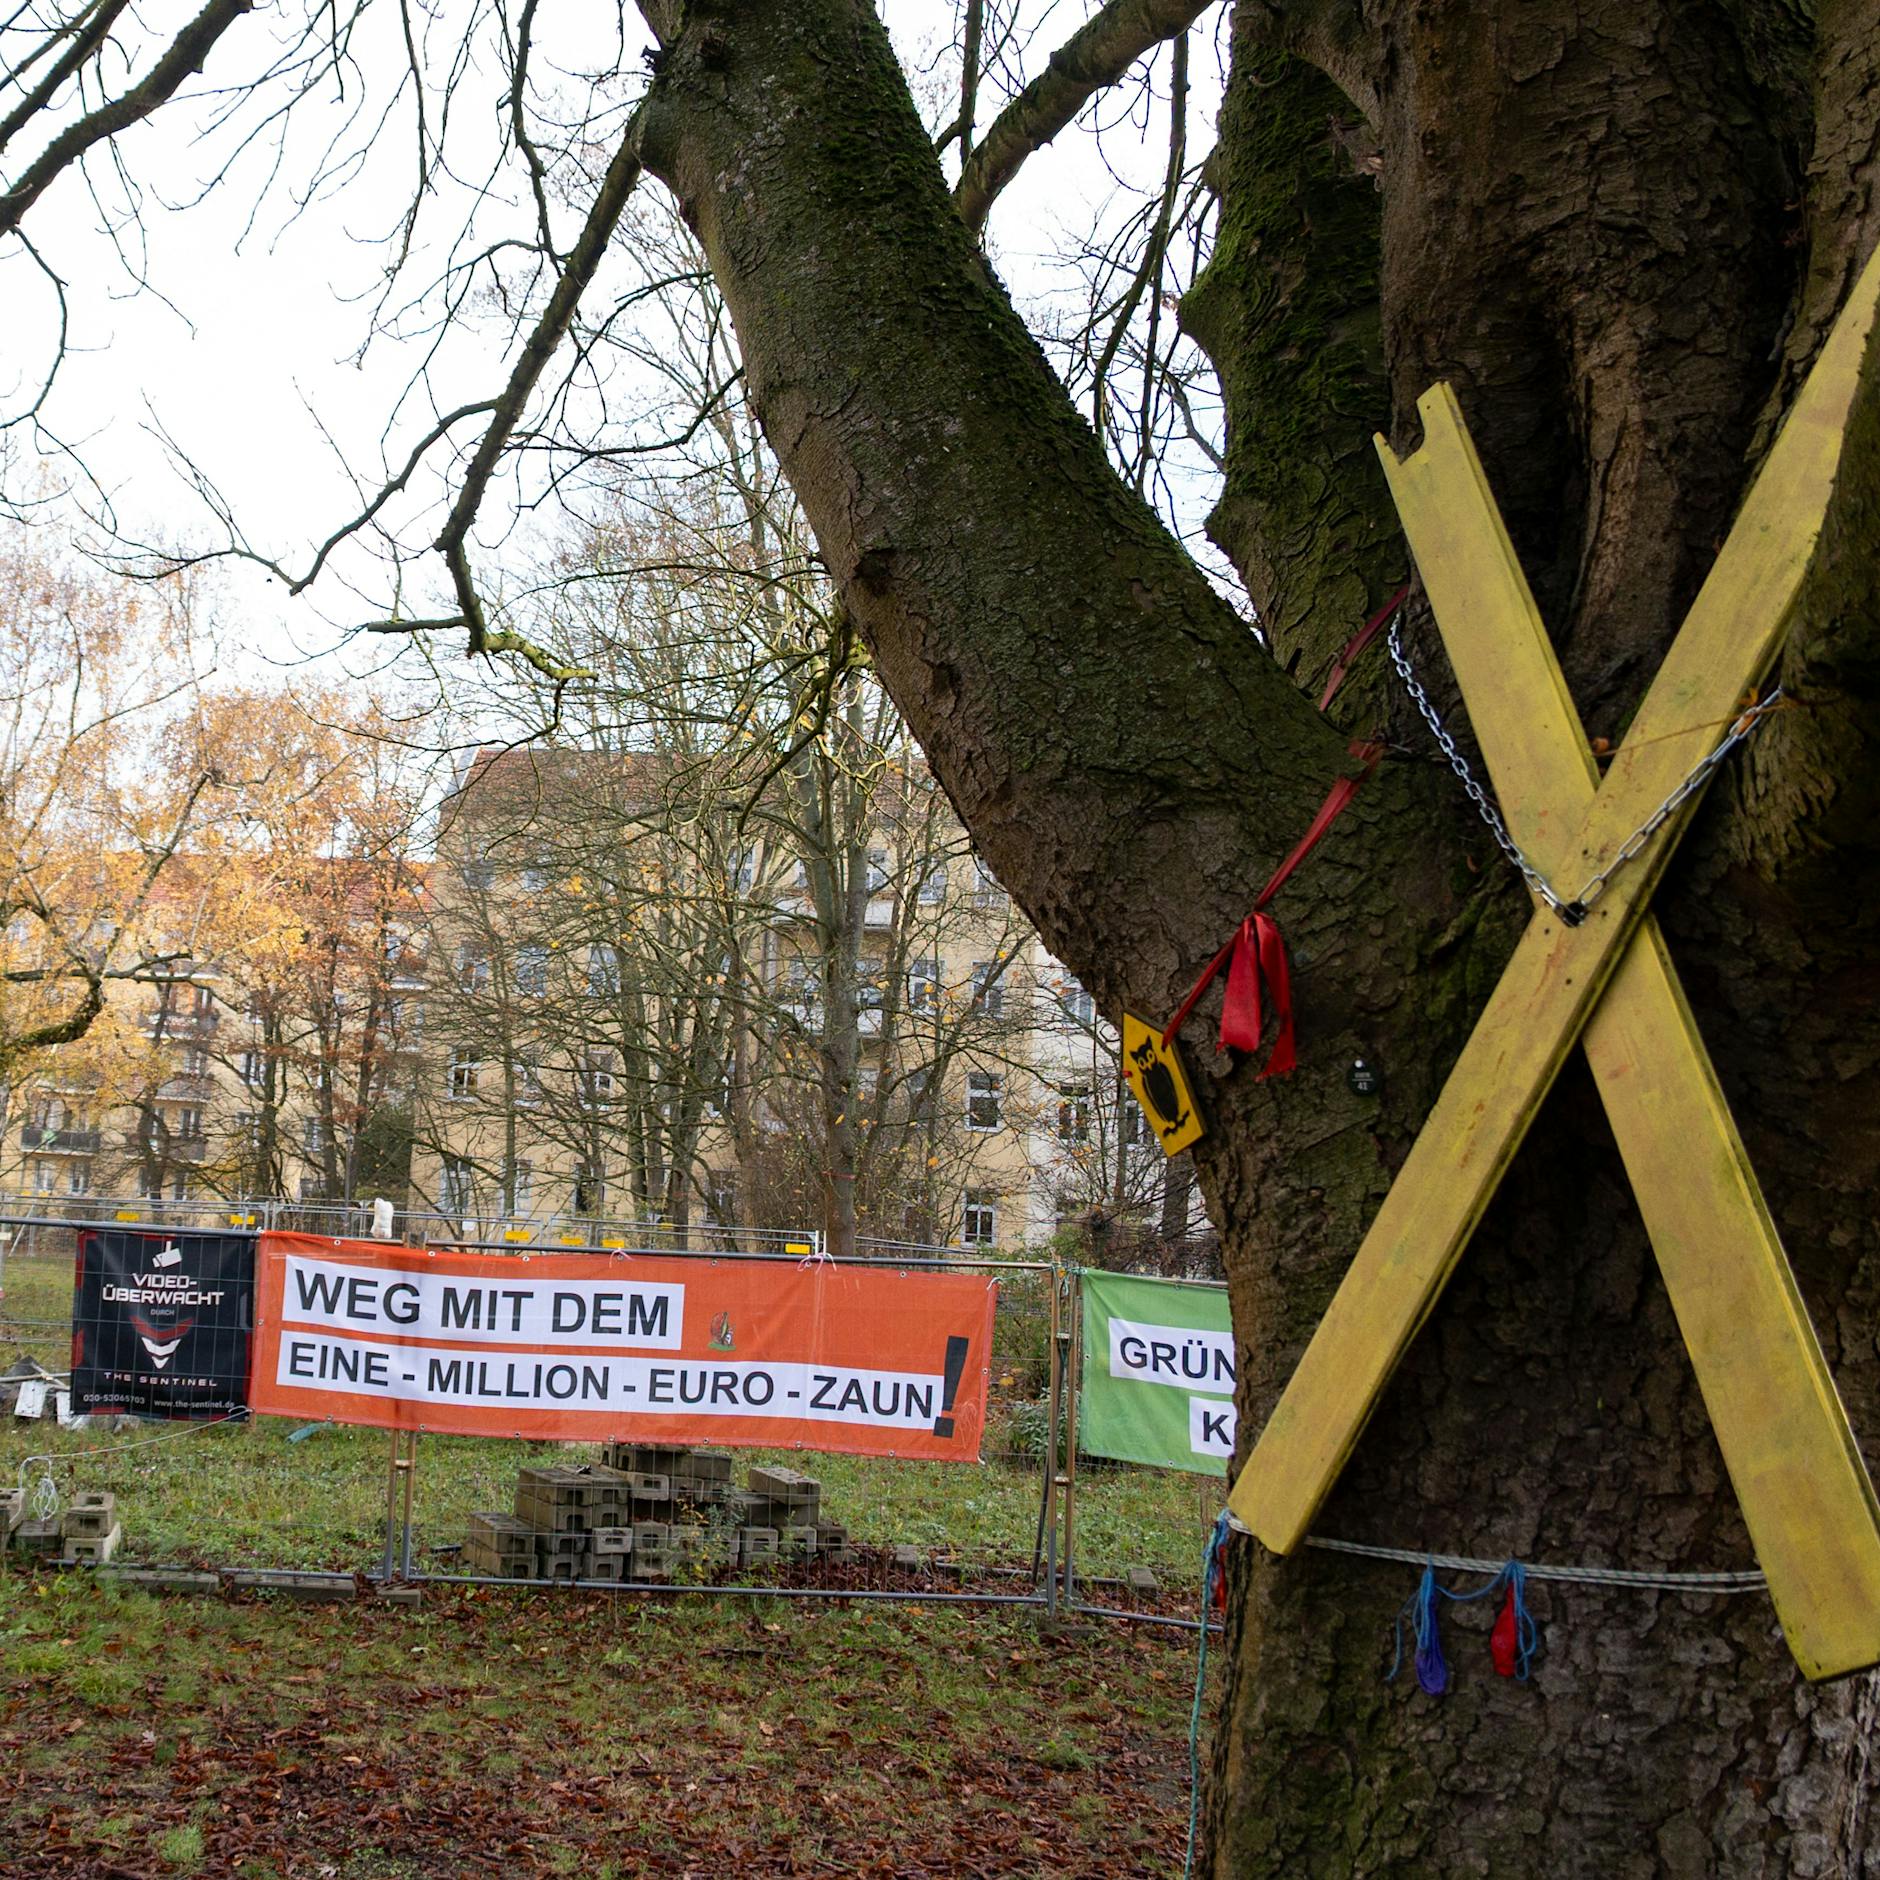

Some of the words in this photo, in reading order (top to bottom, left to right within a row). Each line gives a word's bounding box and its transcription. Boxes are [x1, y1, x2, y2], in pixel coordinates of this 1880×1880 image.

[132, 1273, 198, 1288] VIDEO-
[102, 1284, 225, 1305] ÜBERWACHT
[295, 1268, 421, 1324] WEG
[441, 1286, 534, 1332] MIT
[552, 1292, 669, 1338] DEM
[104, 1372, 132, 1381] THE
[139, 1375, 218, 1387] SENTINEL
[289, 1341, 389, 1387] EINE
[427, 1358, 610, 1400] MILLION
[648, 1368, 774, 1405] EURO
[154, 1399, 234, 1409] www.the-sentinel.de
